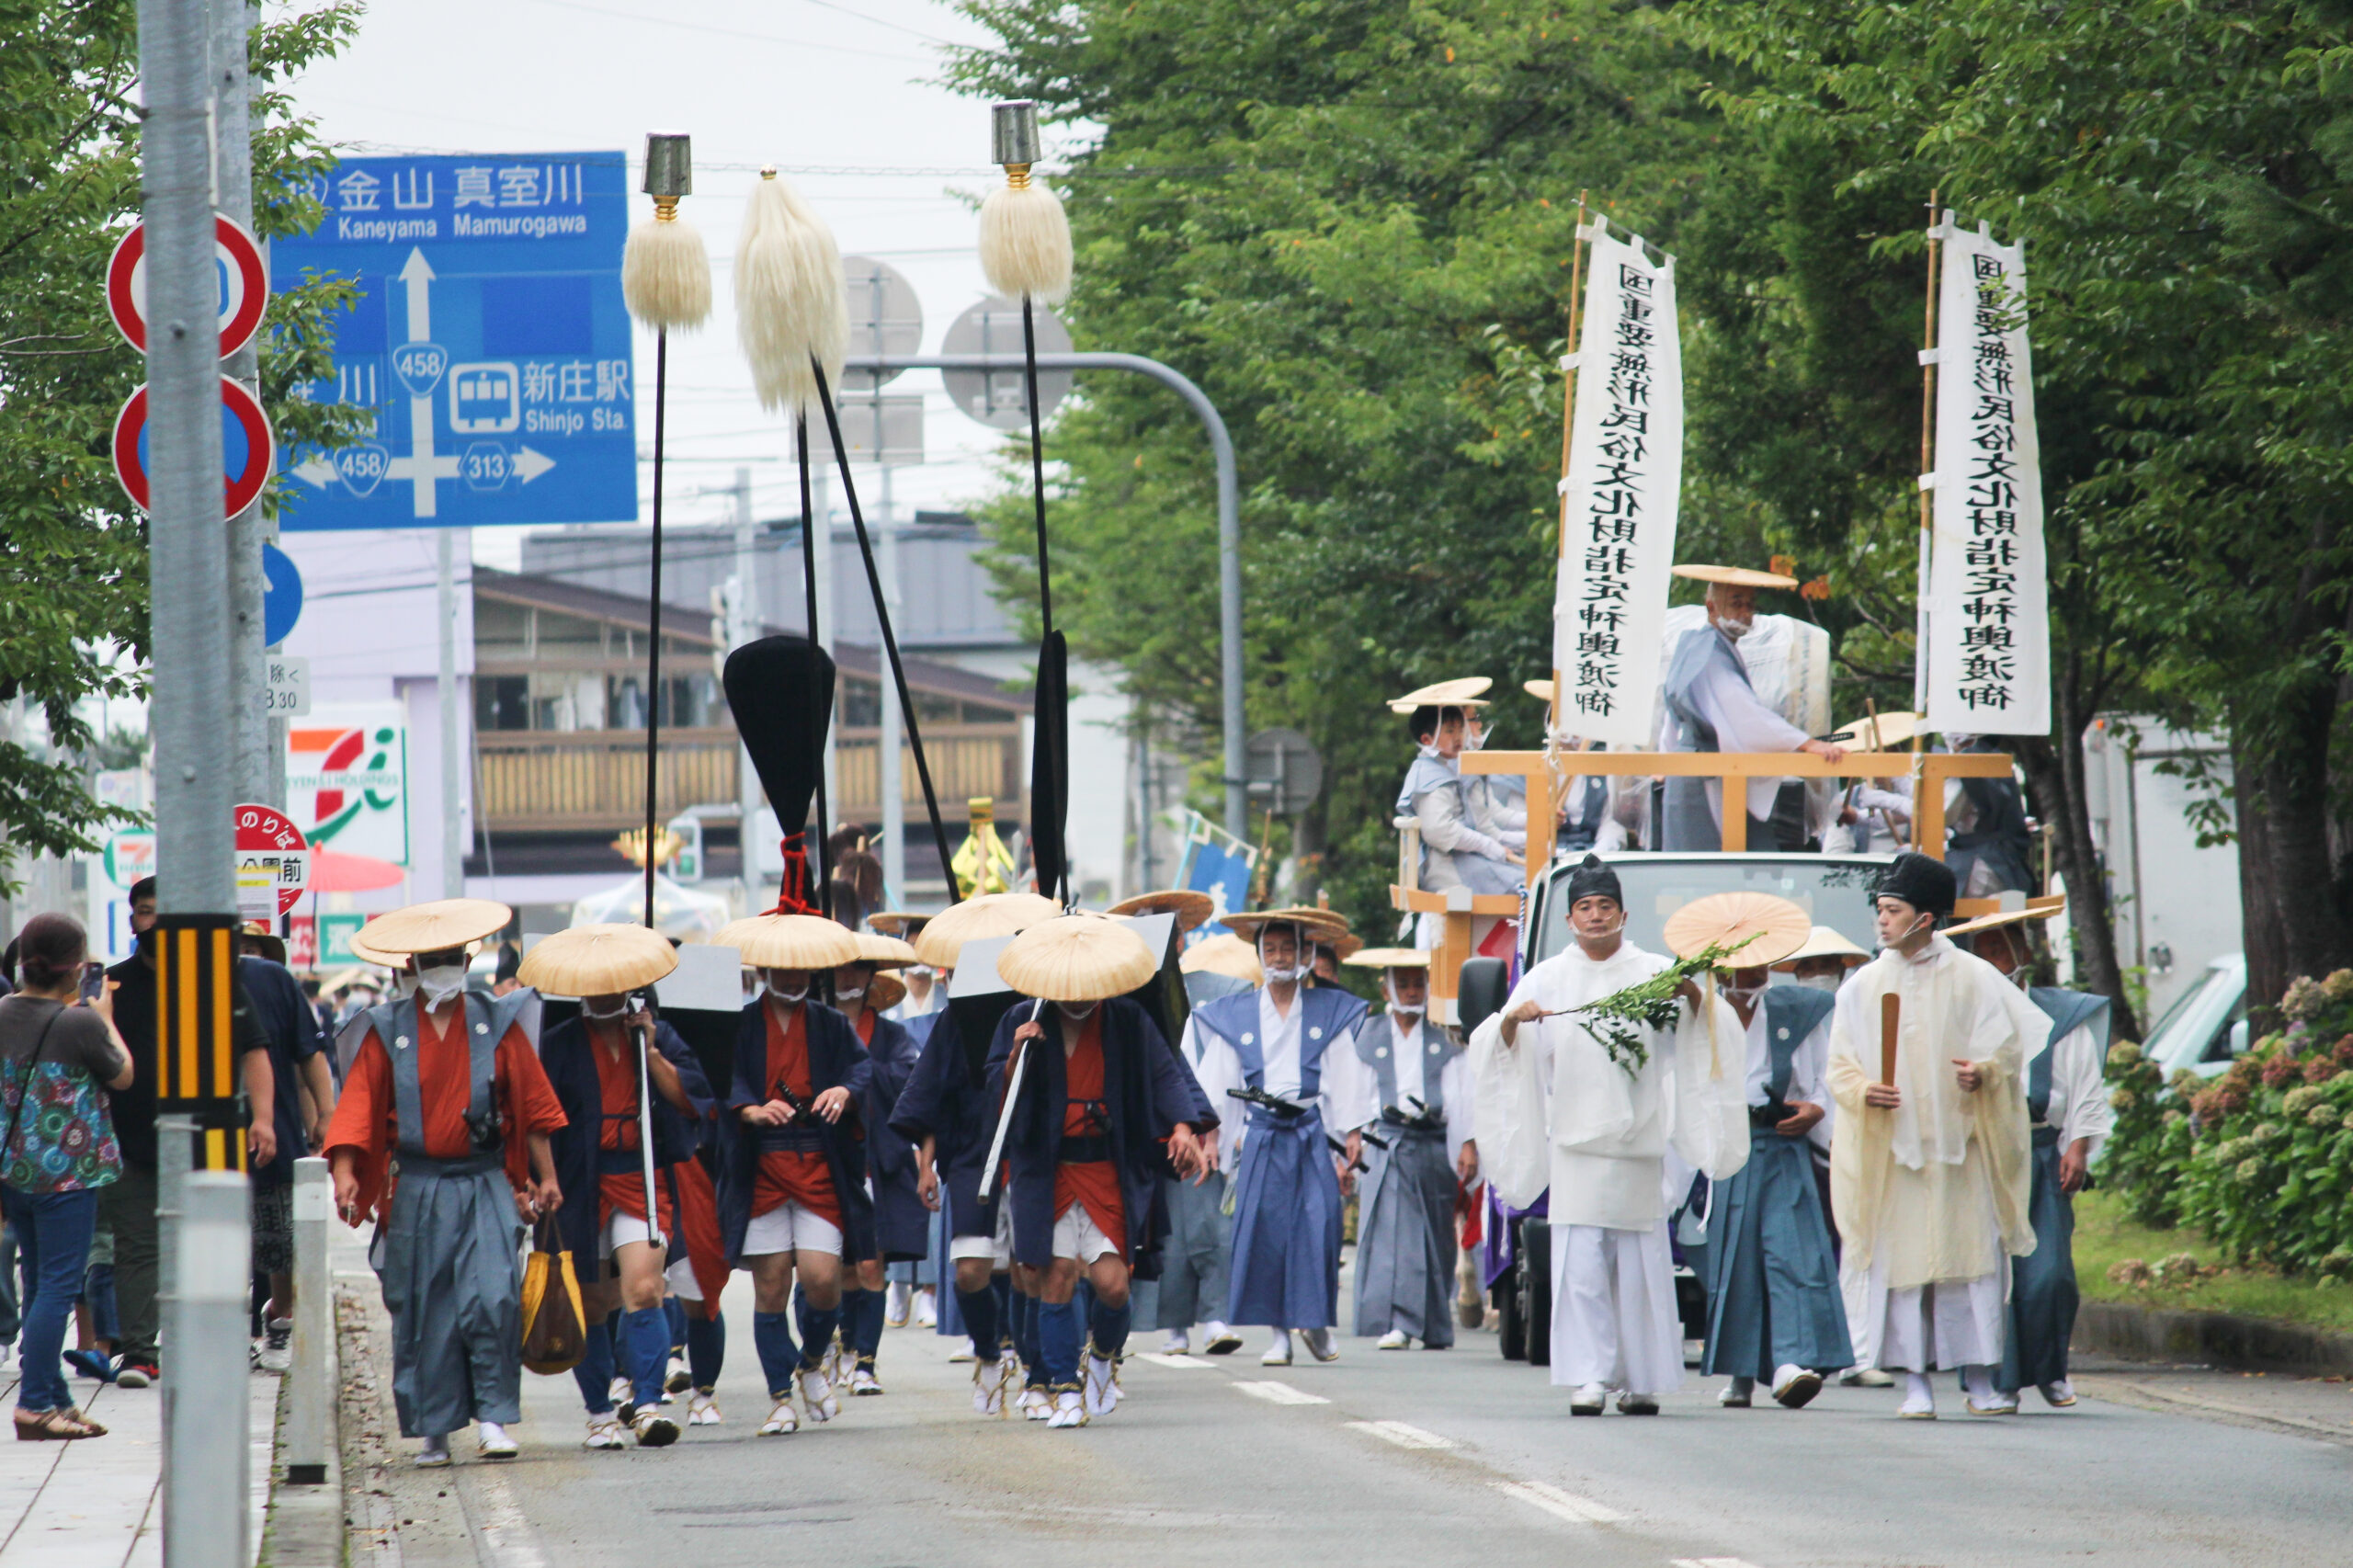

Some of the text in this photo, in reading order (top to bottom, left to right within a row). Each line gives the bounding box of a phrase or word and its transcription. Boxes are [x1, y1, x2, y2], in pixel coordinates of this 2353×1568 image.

[338, 164, 583, 210] 金山 真室川
[338, 213, 586, 243] Kaneyama Mamurogawa
[400, 353, 441, 376] 458
[523, 359, 631, 403] 新庄駅
[526, 409, 585, 436] Shinjo
[341, 452, 382, 477] 458
[469, 454, 506, 479] 313
[270, 664, 300, 683] 除く
[235, 812, 296, 850] のりば
